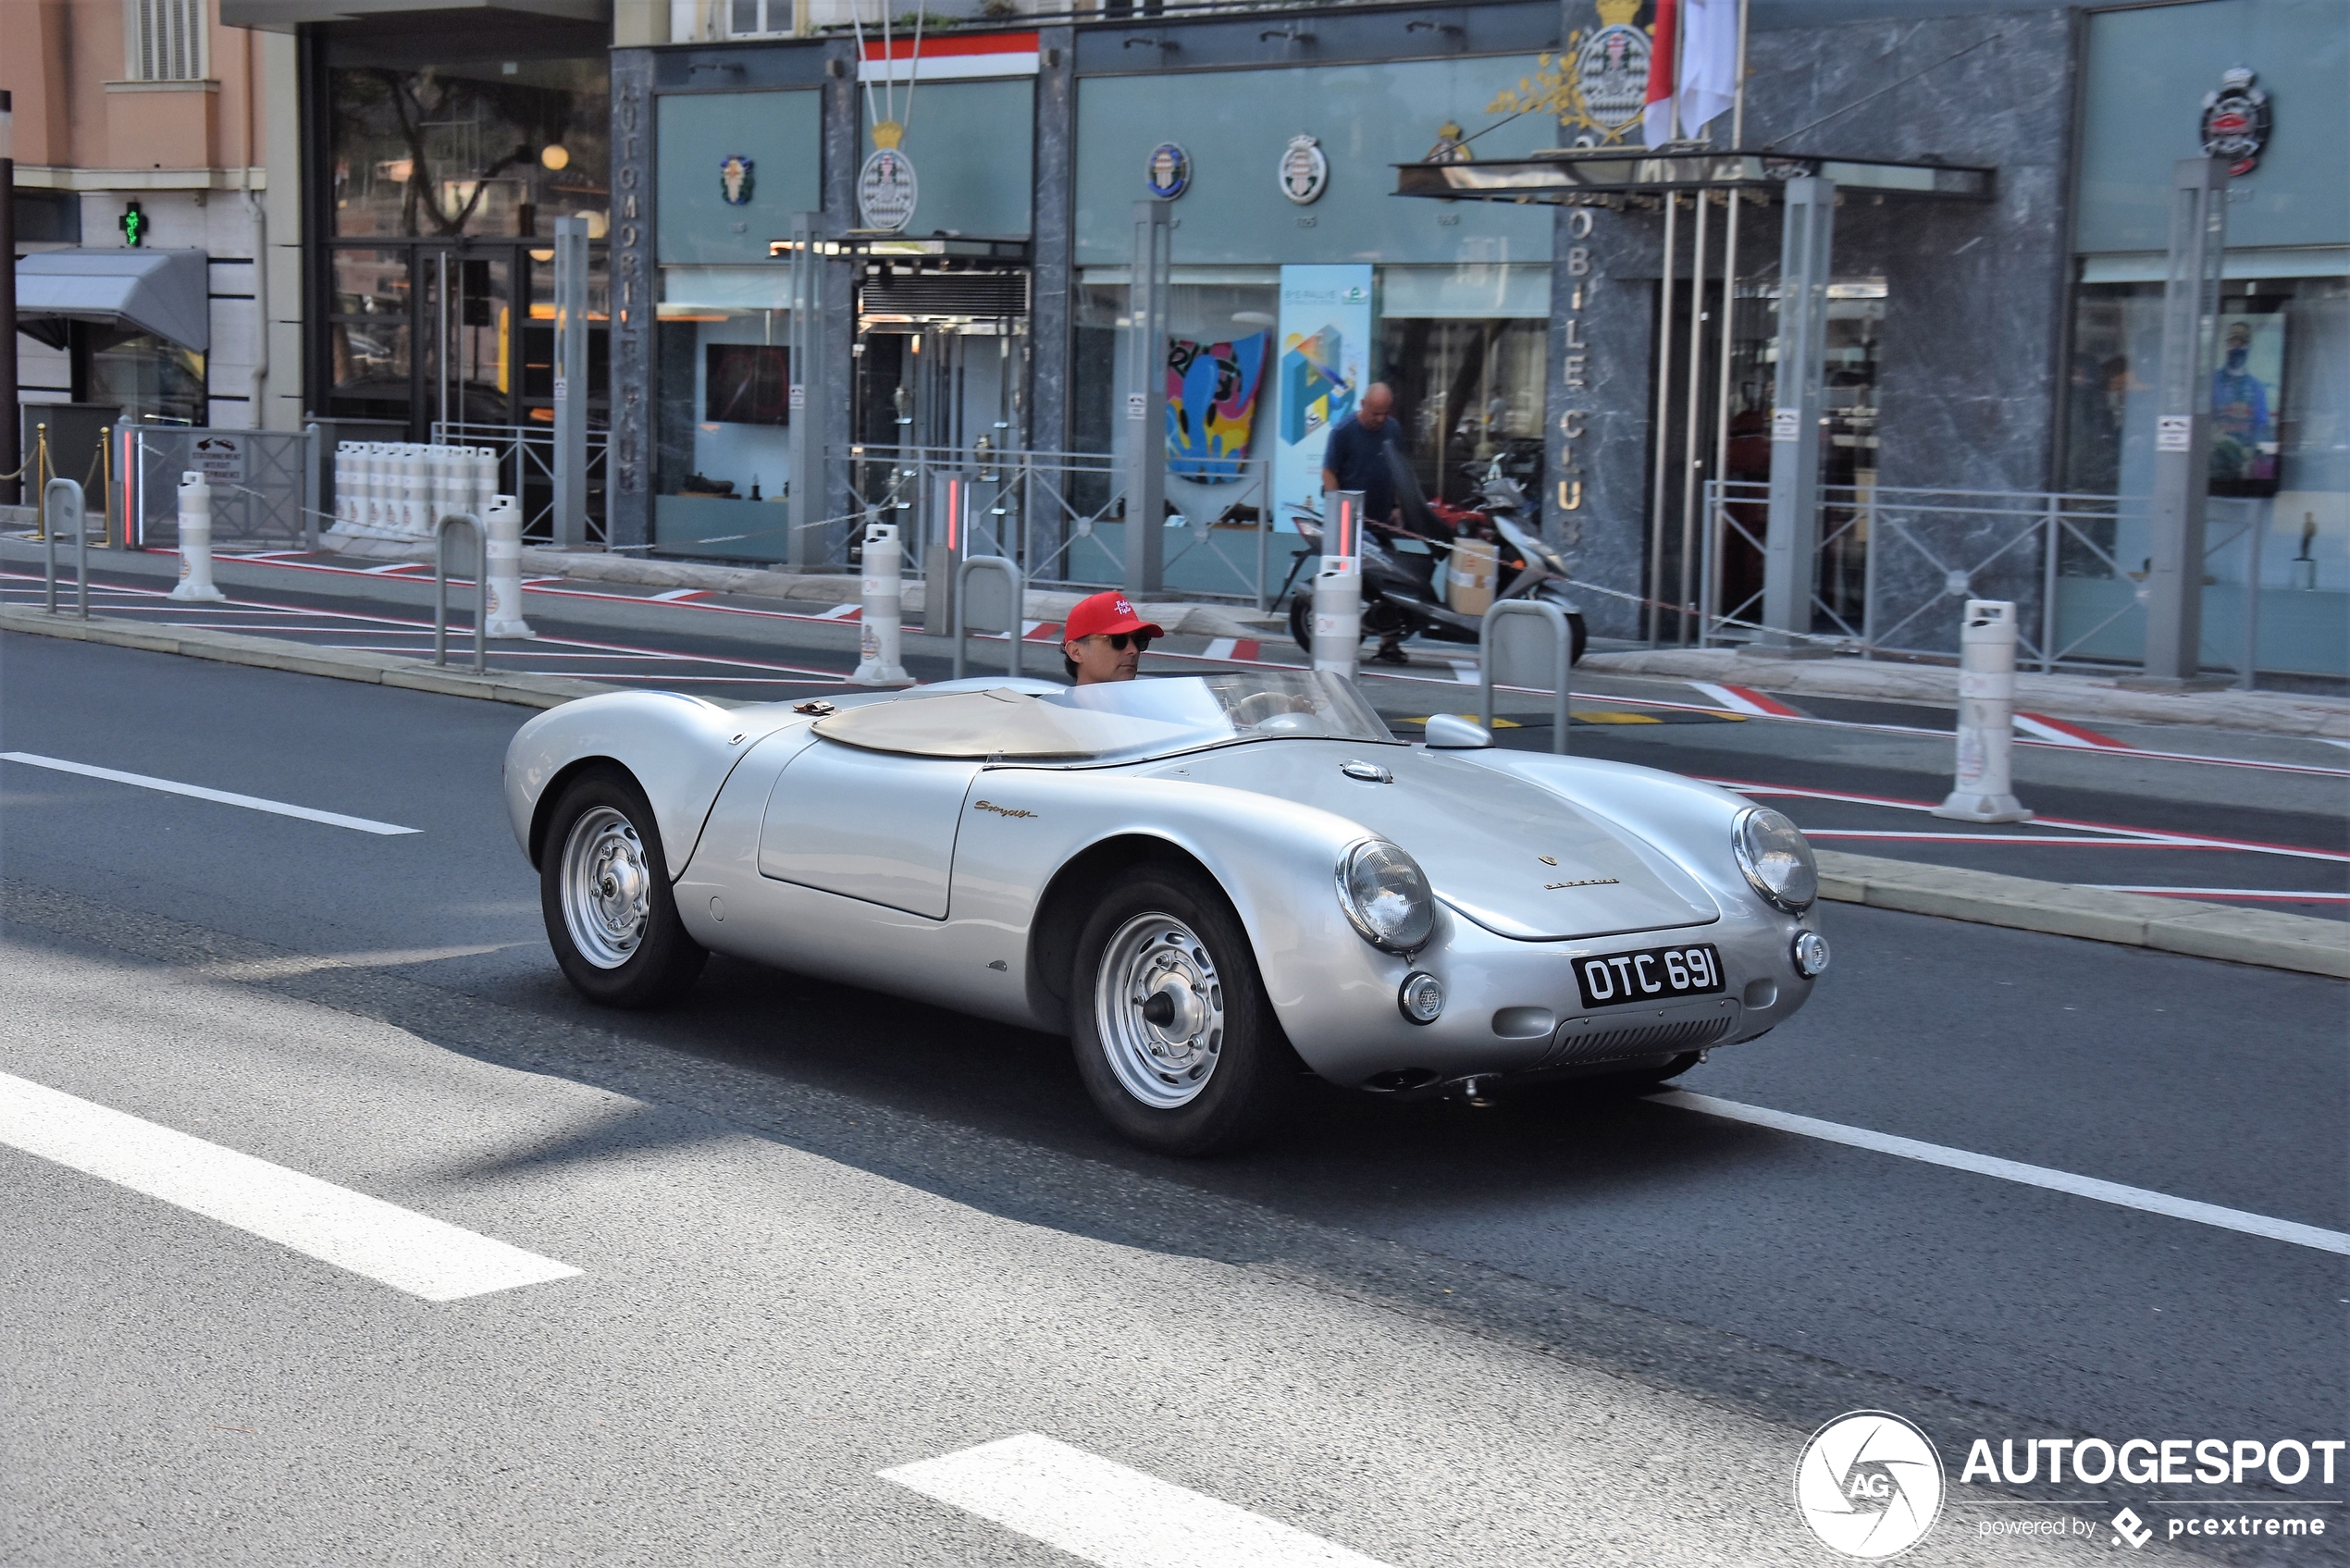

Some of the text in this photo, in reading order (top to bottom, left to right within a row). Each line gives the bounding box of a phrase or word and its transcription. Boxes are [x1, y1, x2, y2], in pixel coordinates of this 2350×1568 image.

[1558, 409, 1587, 547] CLUB
[974, 800, 1038, 818] Spyder
[1585, 948, 1718, 1000] OTC 691
